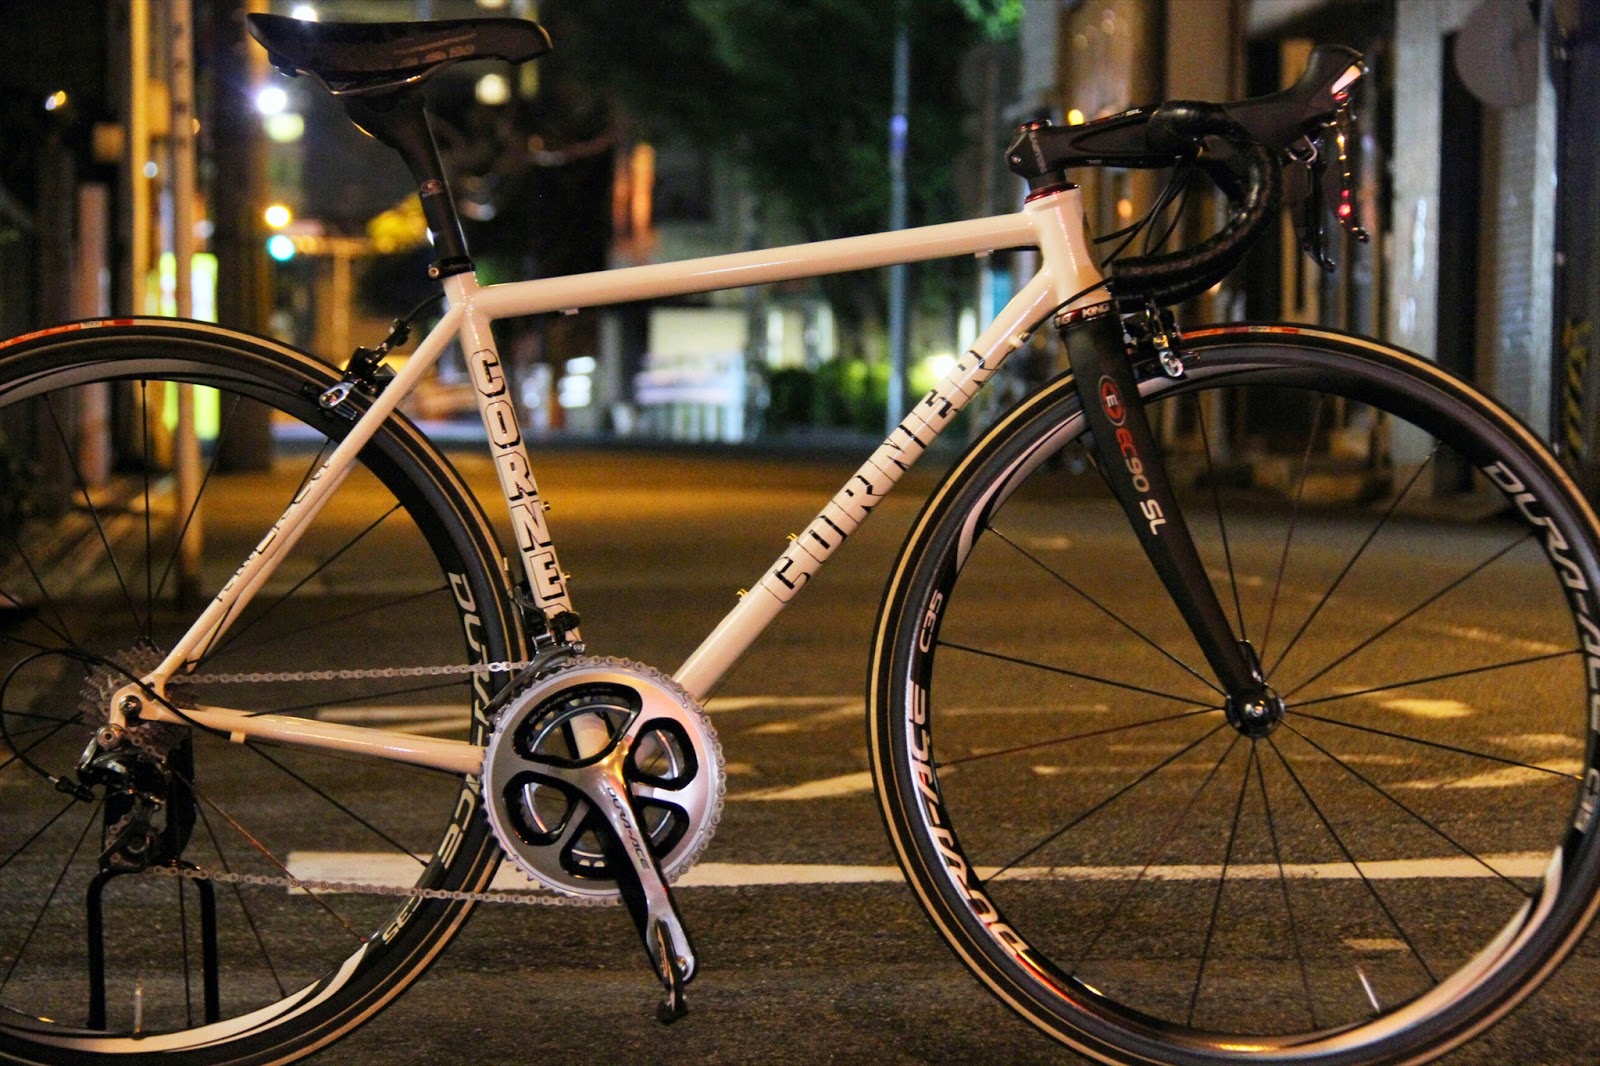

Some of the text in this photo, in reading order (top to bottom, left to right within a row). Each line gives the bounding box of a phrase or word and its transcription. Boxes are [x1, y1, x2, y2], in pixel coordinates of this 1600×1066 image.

[1115, 427, 1150, 493] EC90
[1139, 500, 1167, 536] SL
[919, 589, 943, 653] C35
[606, 785, 651, 870] DURA-ACE
[908, 680, 1031, 956] DURA-ACE
